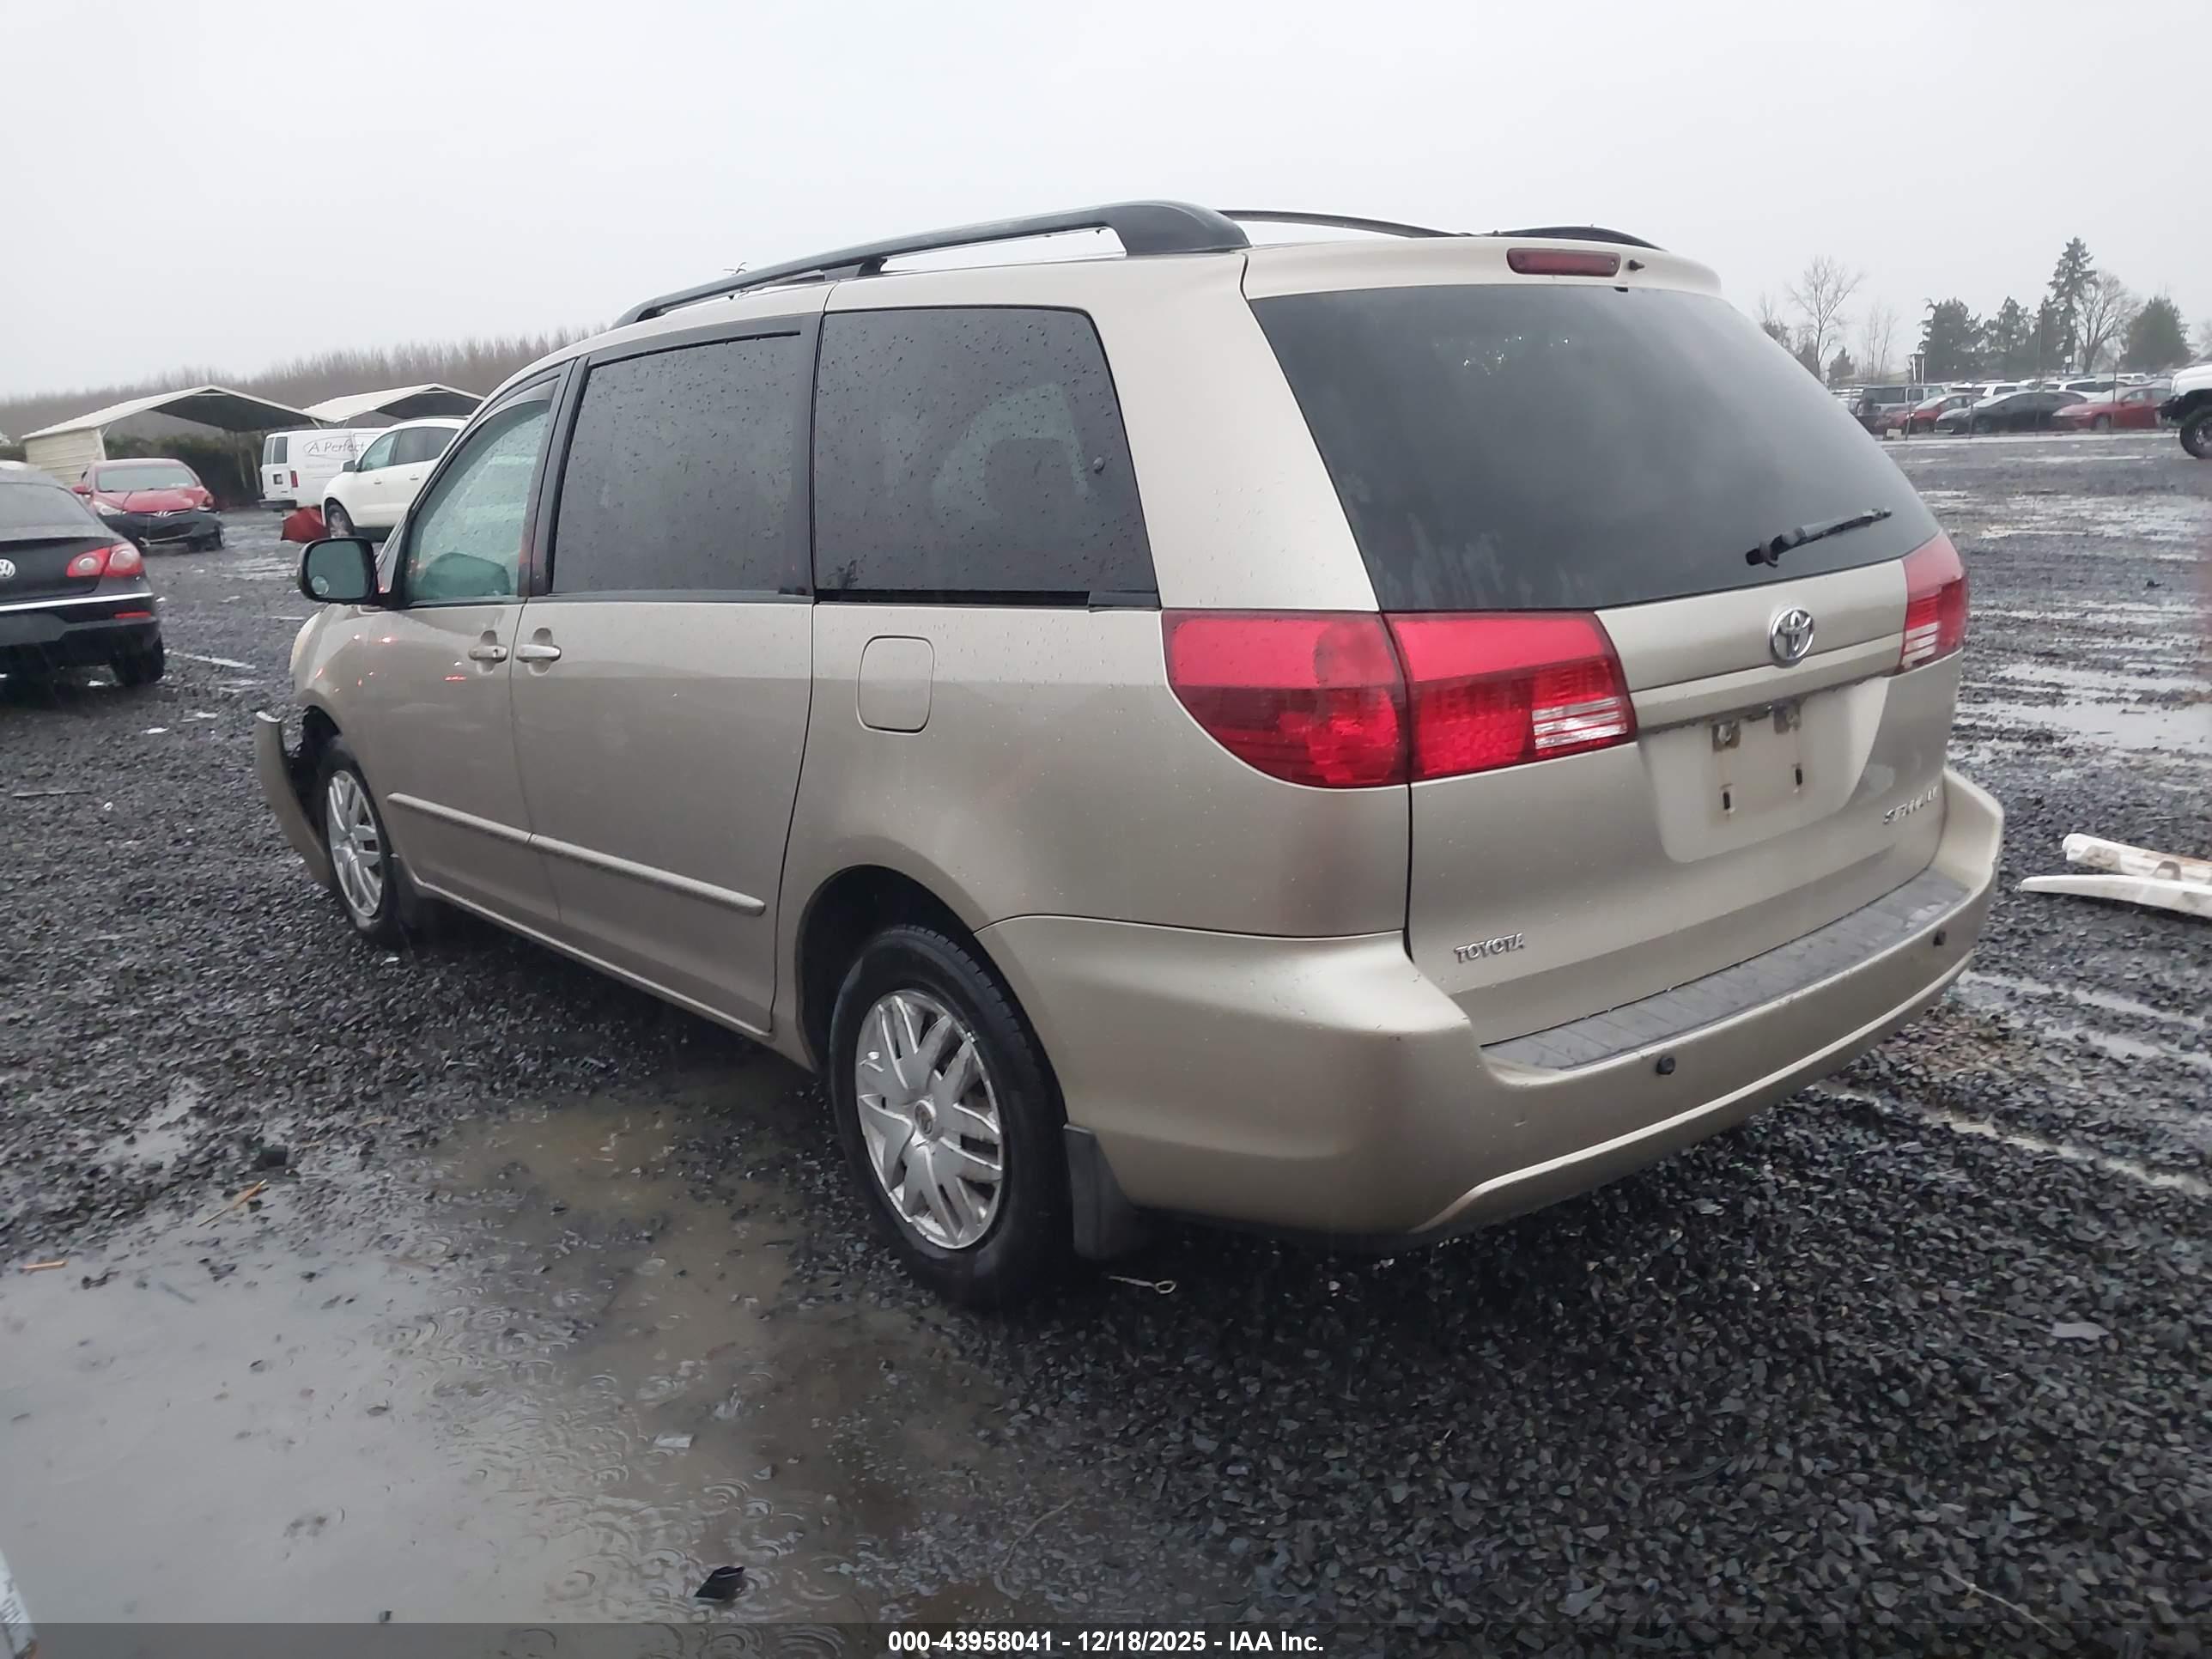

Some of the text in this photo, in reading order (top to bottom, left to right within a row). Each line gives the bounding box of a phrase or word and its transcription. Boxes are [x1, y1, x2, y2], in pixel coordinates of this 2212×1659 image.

[308, 437, 365, 453] A Perfect
[1454, 933, 1524, 963] TOYOTA
